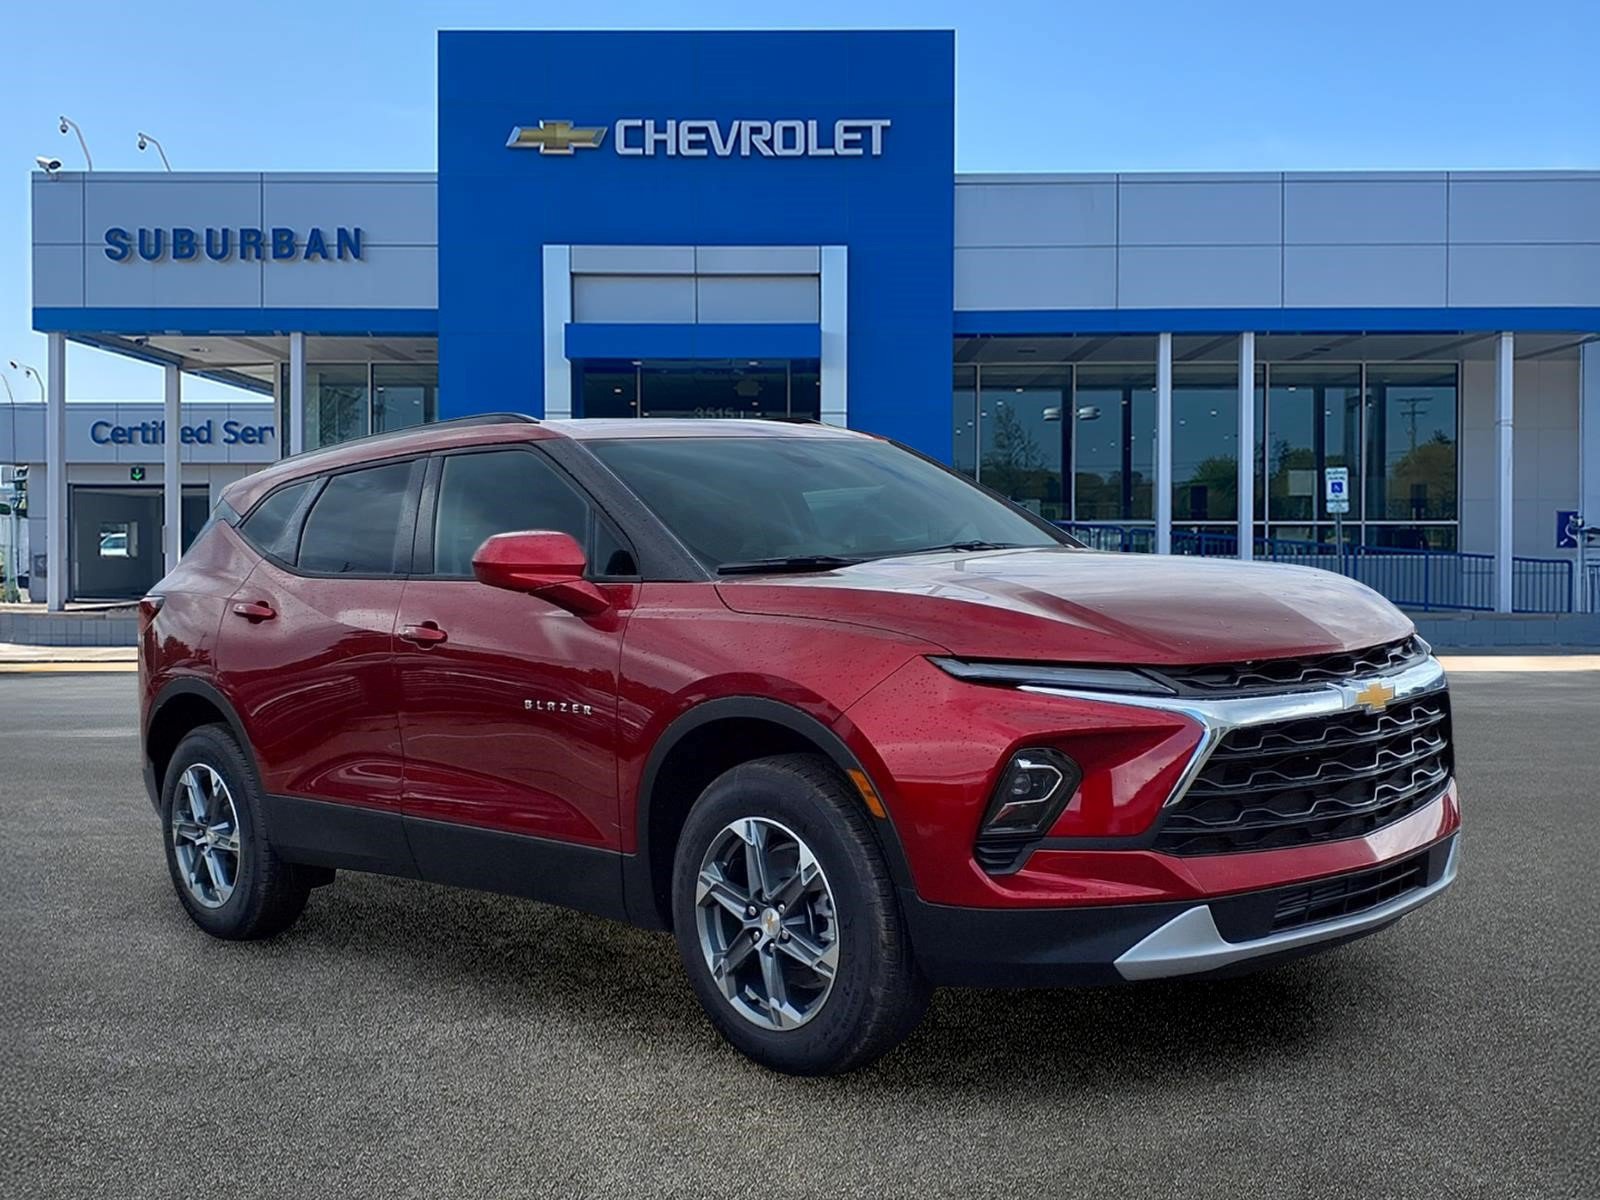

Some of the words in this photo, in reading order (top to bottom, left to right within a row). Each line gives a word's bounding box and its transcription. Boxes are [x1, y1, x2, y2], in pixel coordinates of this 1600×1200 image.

[614, 119, 892, 156] CHEVROLET
[104, 227, 362, 261] SUBURBAN
[90, 420, 213, 445] Certifed
[524, 699, 592, 715] BLAZER
